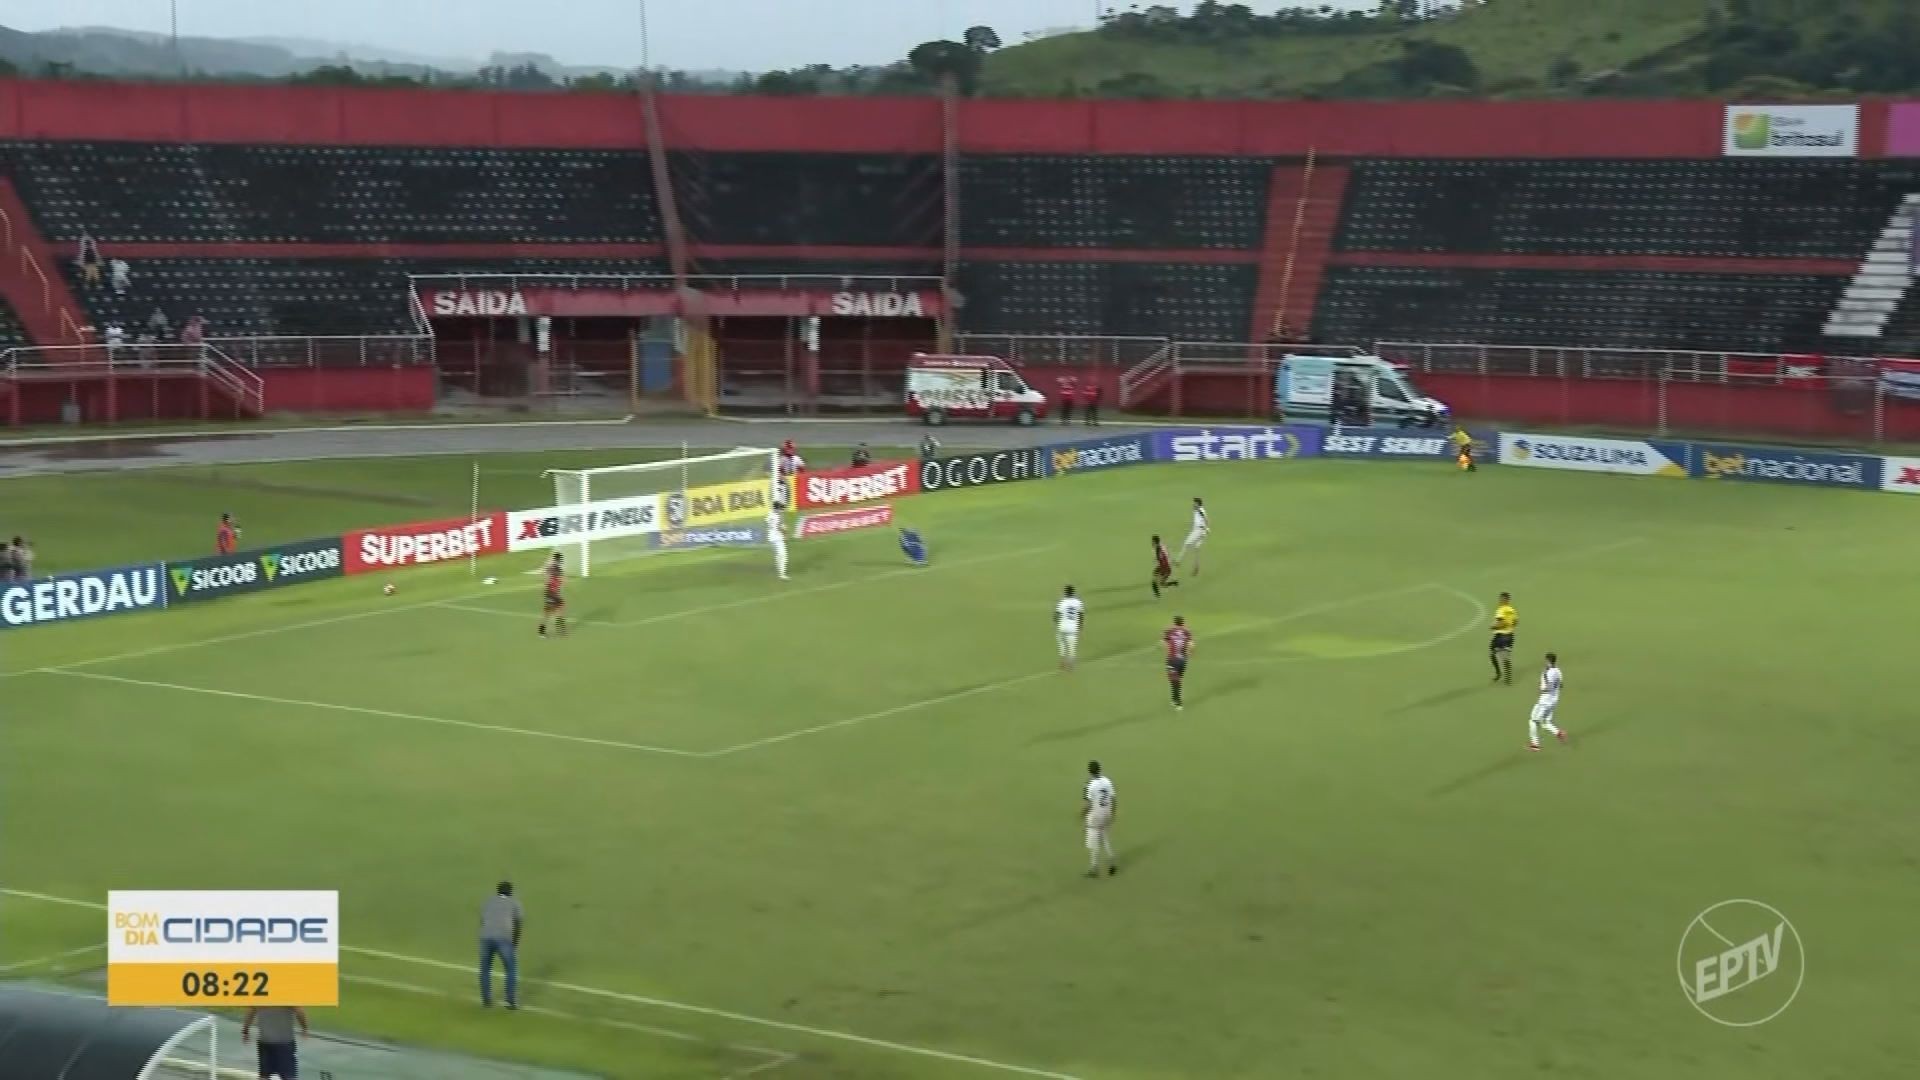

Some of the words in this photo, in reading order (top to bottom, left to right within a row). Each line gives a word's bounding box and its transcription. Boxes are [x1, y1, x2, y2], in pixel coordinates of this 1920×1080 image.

[434, 290, 528, 315] SAIDA
[832, 291, 924, 316] SAIDA
[1051, 441, 1144, 474] betnacional
[1170, 429, 1284, 461] start
[1323, 435, 1376, 453] SEST
[1380, 437, 1447, 456] SENAT
[1534, 443, 1599, 463] SOUZA
[1600, 449, 1647, 467] LIMA
[1703, 451, 1863, 484] betnacional
[805, 464, 910, 503] SUPERBET
[600, 505, 655, 529] PNEUS
[691, 495, 725, 517] BOA
[728, 489, 765, 511] IDEIA
[806, 510, 892, 533] SUPERBET
[360, 518, 493, 565] SUPERBET
[192, 562, 258, 591] SICOOB
[280, 548, 340, 577] SICOOB
[1, 568, 157, 626] GERDAU
